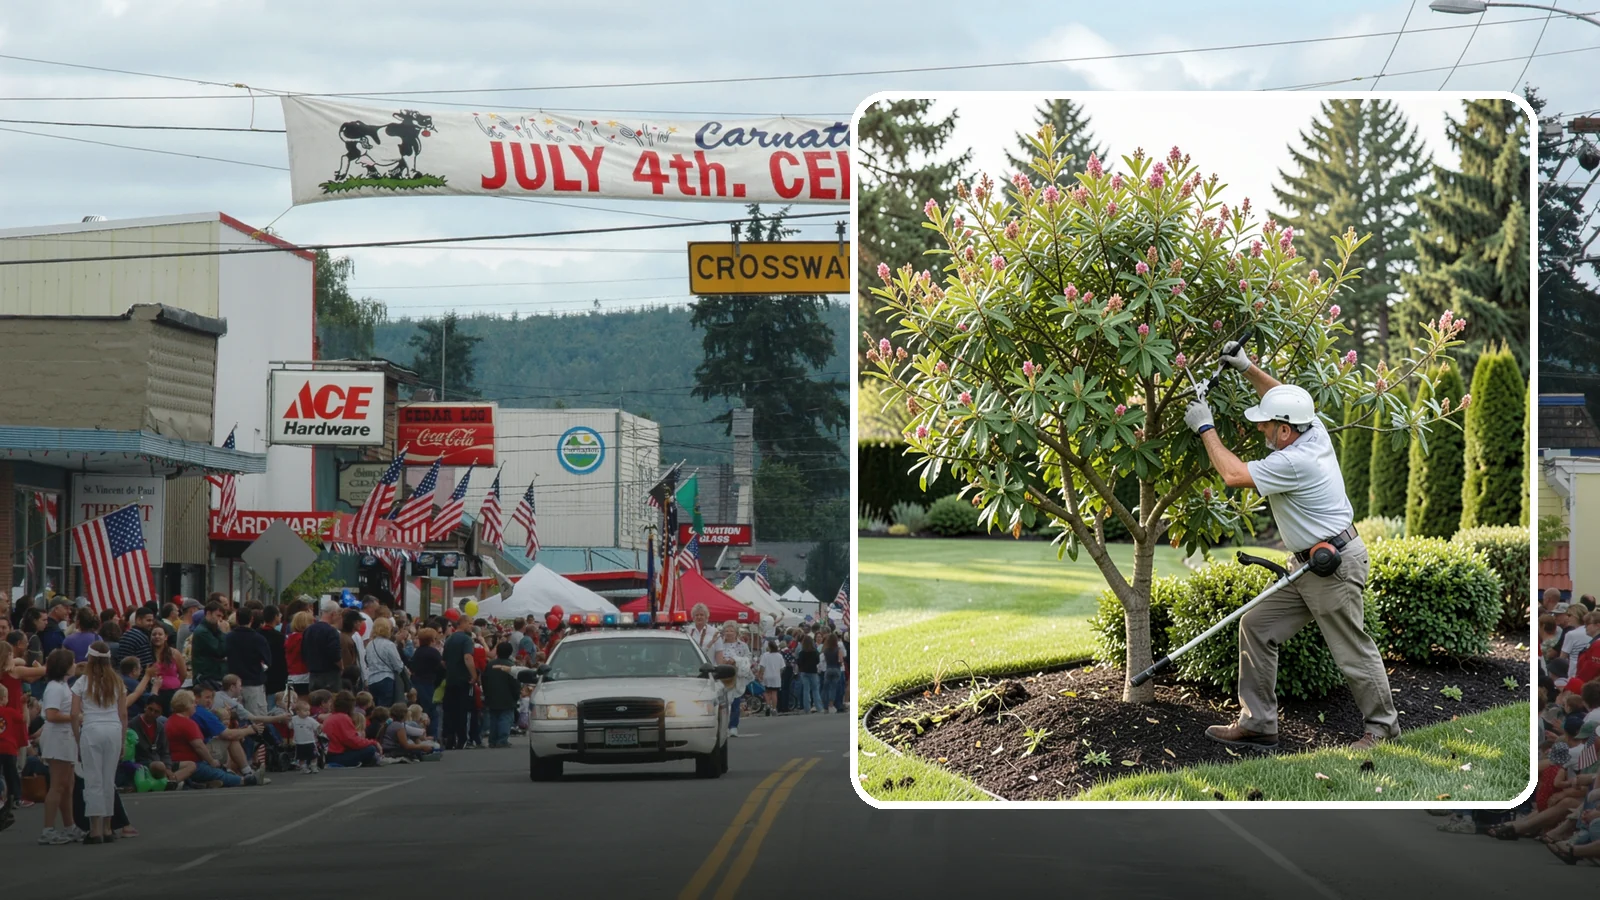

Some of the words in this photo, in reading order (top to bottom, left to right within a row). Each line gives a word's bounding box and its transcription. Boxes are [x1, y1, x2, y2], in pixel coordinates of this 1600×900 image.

[481, 140, 605, 192] JULY
[632, 150, 746, 198] 4th.
[696, 254, 850, 280] CROSSWA
[283, 380, 373, 420] ACE
[405, 409, 452, 422] CEDAR
[283, 421, 371, 436] Hardware
[416, 428, 477, 447] Coca-Cola
[96, 484, 124, 495] Vincent
[126, 486, 135, 495] de
[138, 486, 155, 496] Paul
[688, 526, 741, 535] CRNATION
[699, 535, 730, 543] GLASS
